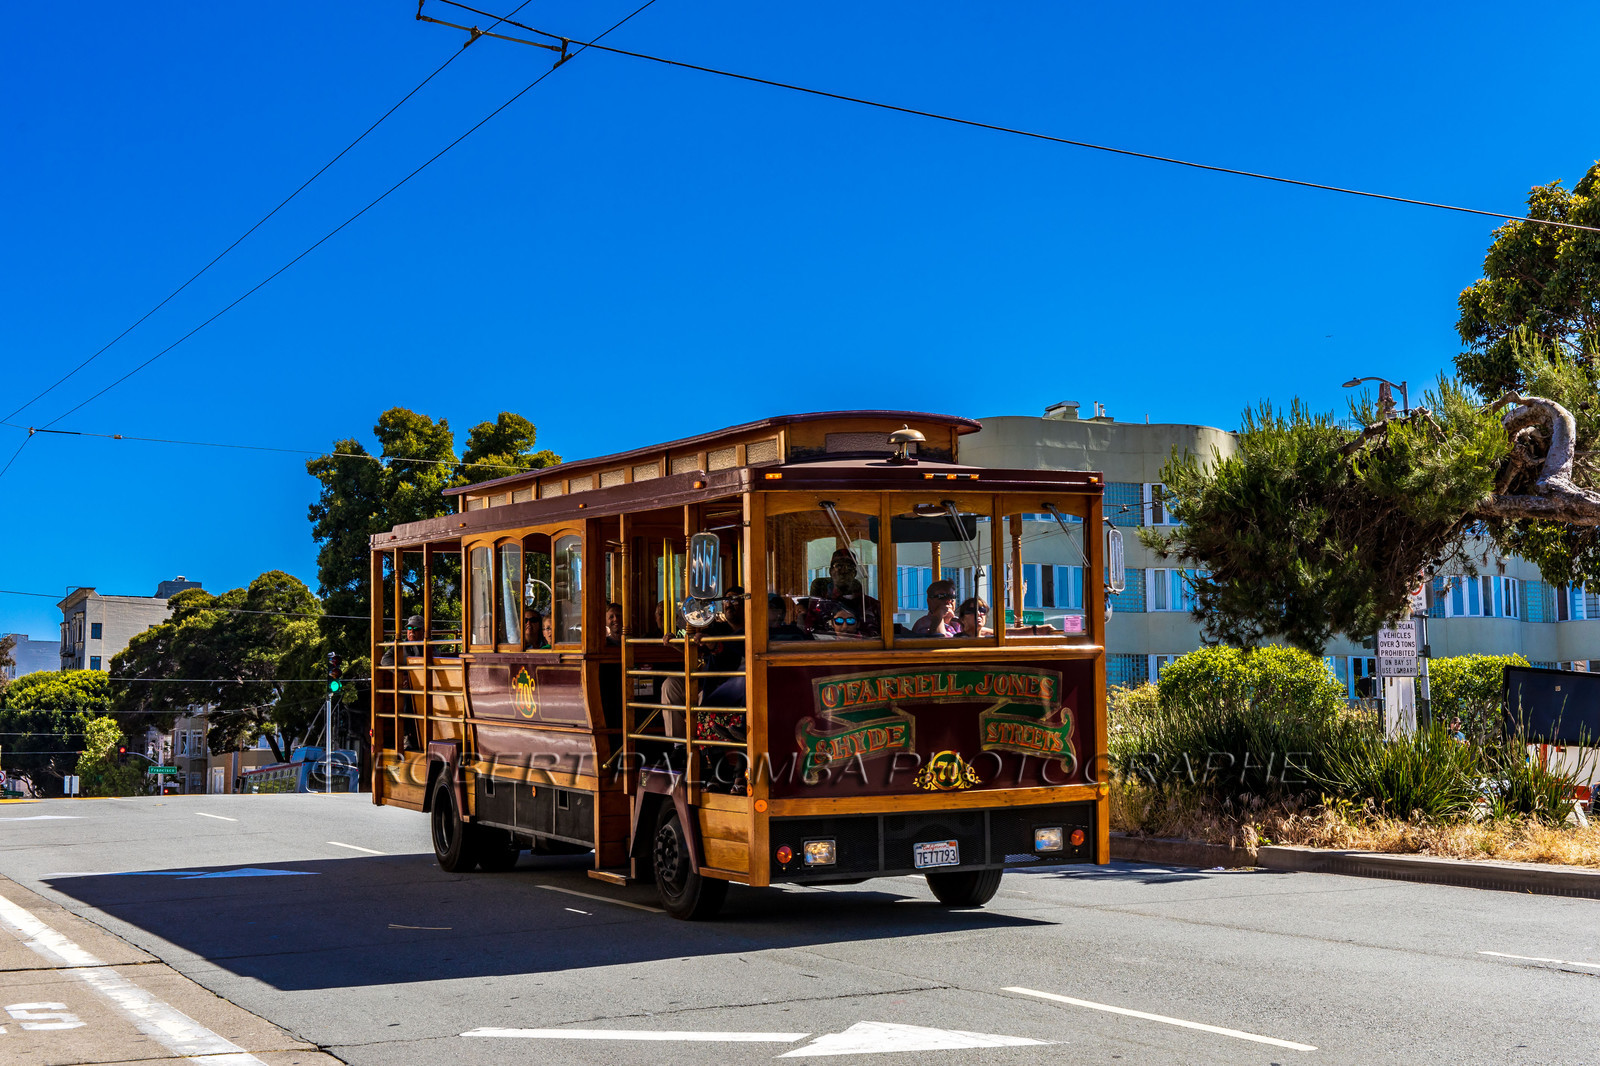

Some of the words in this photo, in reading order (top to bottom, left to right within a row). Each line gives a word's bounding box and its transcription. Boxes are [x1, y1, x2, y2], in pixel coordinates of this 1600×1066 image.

[1380, 640, 1394, 648] OVER
[1395, 640, 1400, 648] 3
[1401, 640, 1415, 648] TONS
[1380, 649, 1415, 657] PROHIBITED
[975, 673, 1055, 700] JONES
[517, 683, 532, 712] 70
[986, 721, 1064, 752] STREETS
[936, 761, 959, 782] 70
[917, 849, 956, 865] 7E77793
